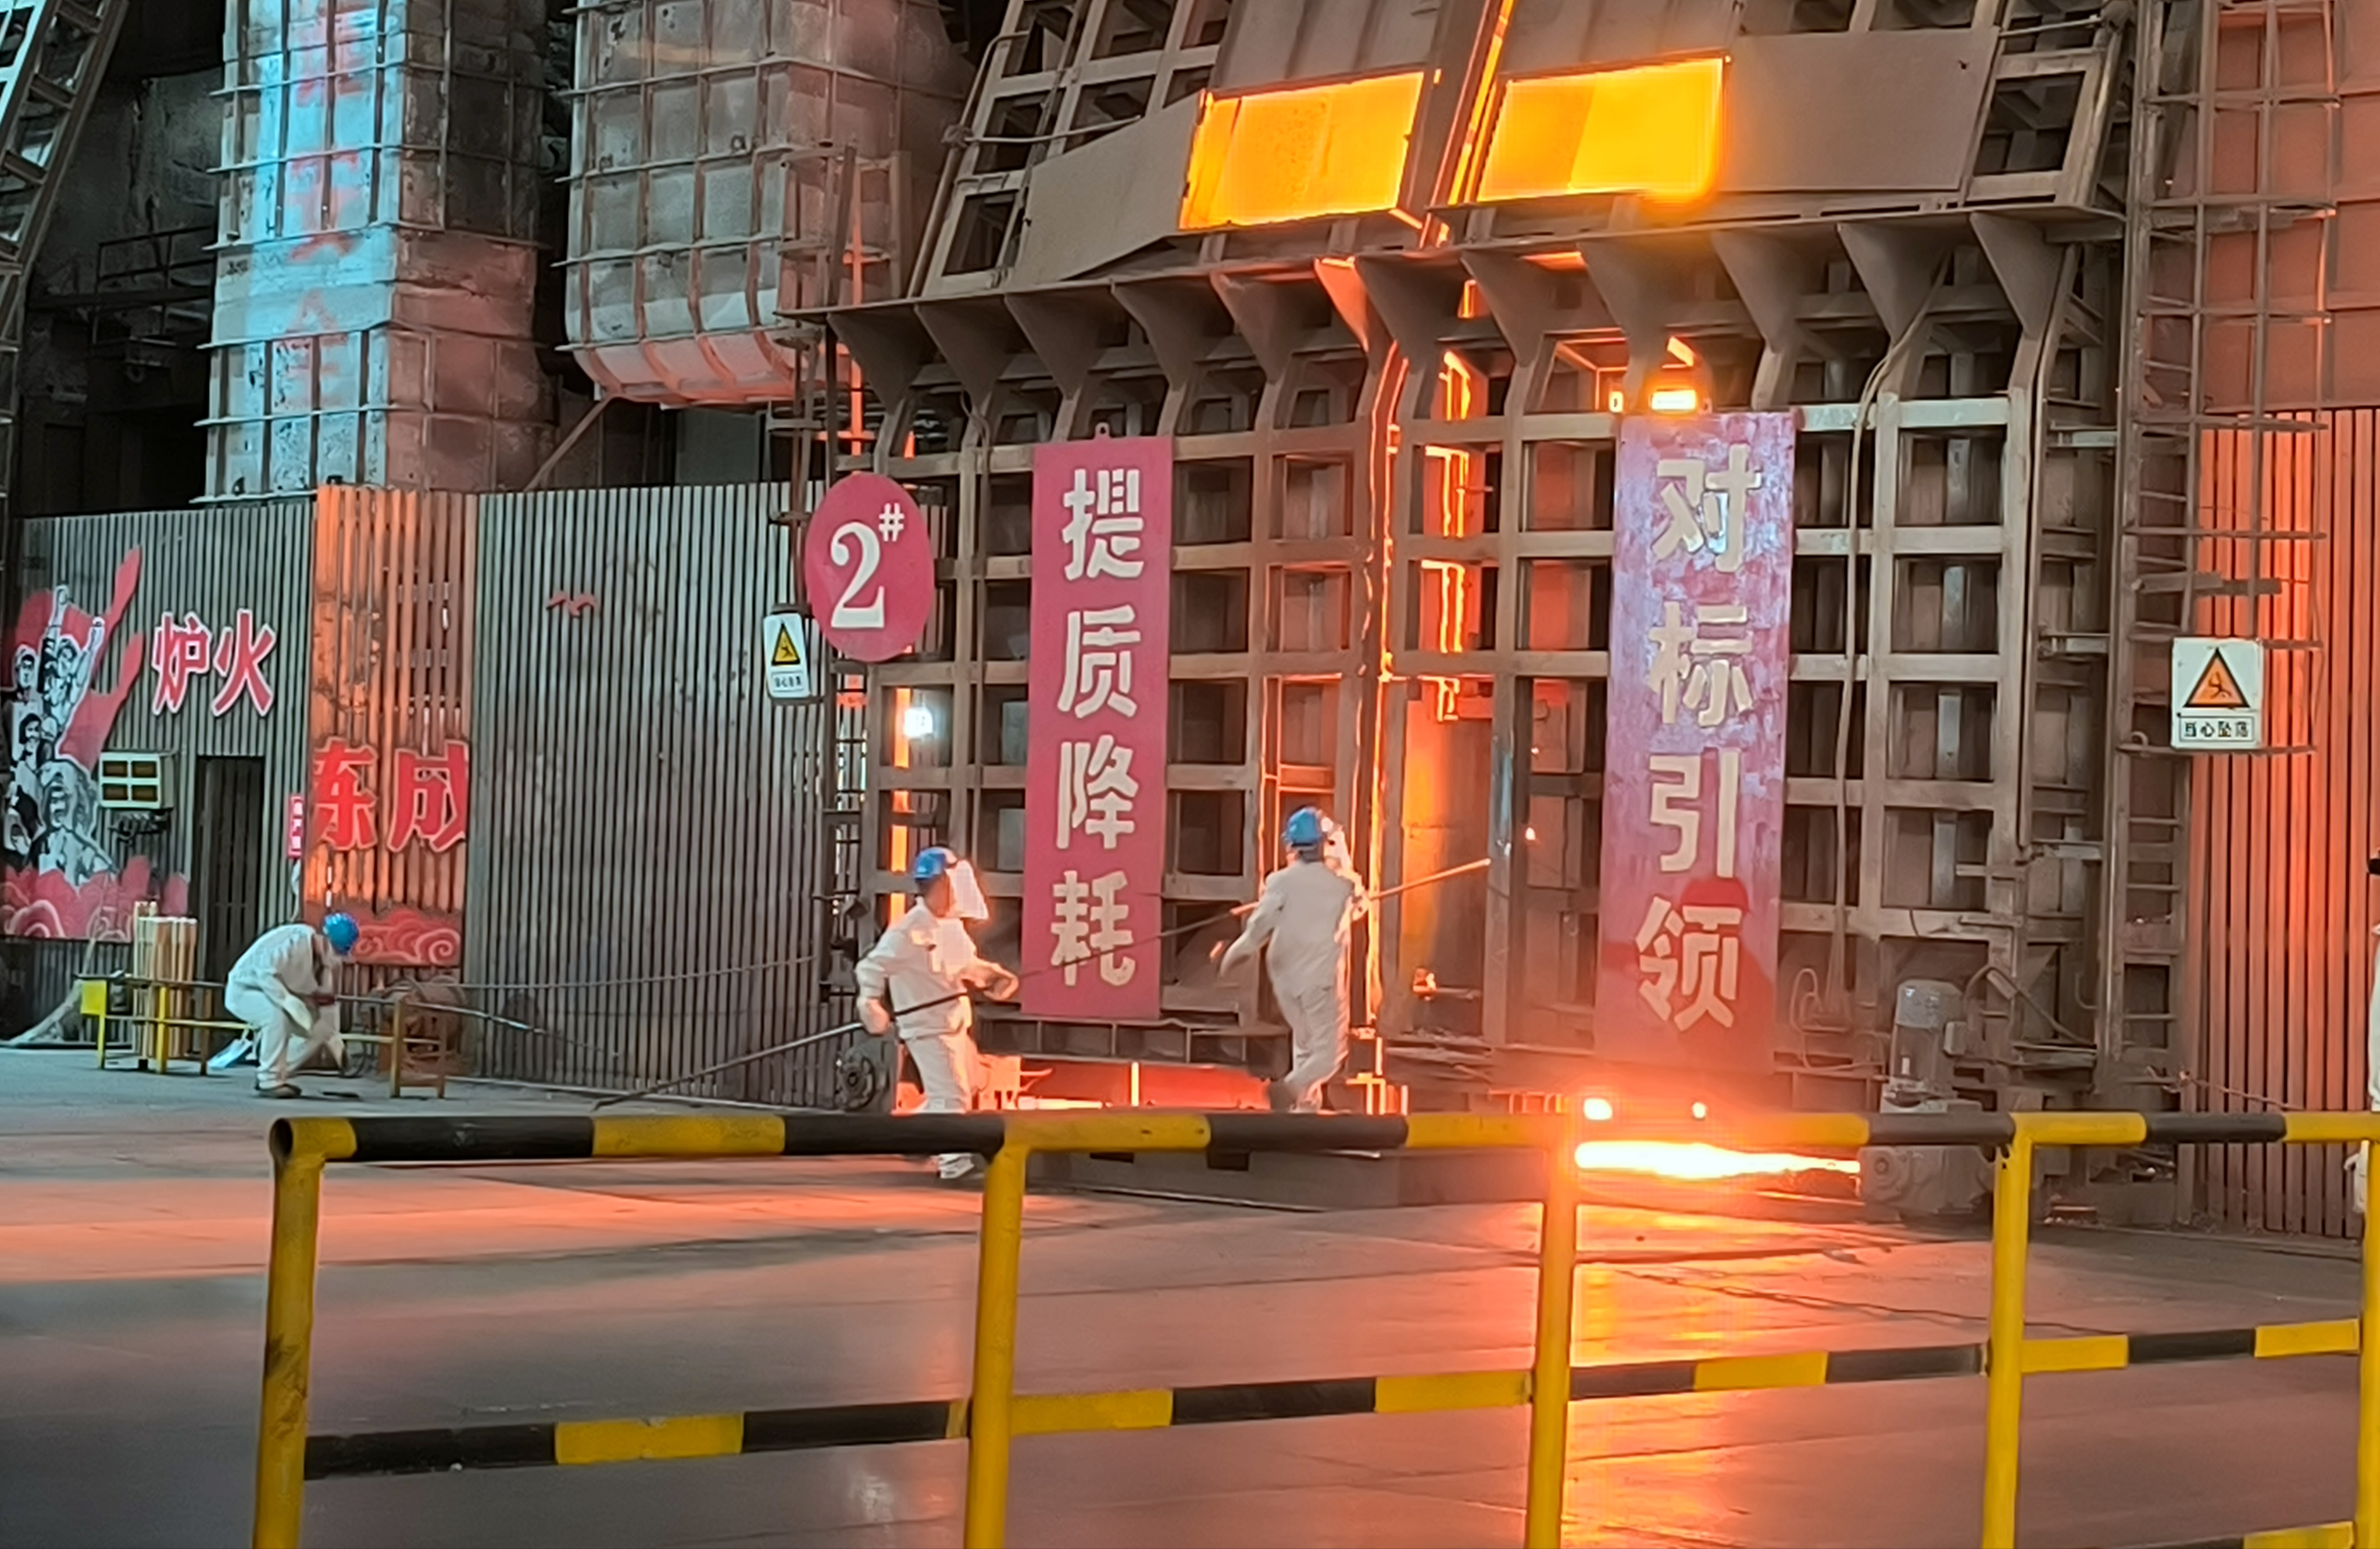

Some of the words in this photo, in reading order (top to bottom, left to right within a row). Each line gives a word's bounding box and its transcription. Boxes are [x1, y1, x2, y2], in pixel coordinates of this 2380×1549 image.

[152, 608, 276, 717] 炉火
[1050, 468, 1146, 988] 提质降耗
[1635, 443, 1761, 1031] 对标引领
[2184, 720, 2249, 738] 当心坠落
